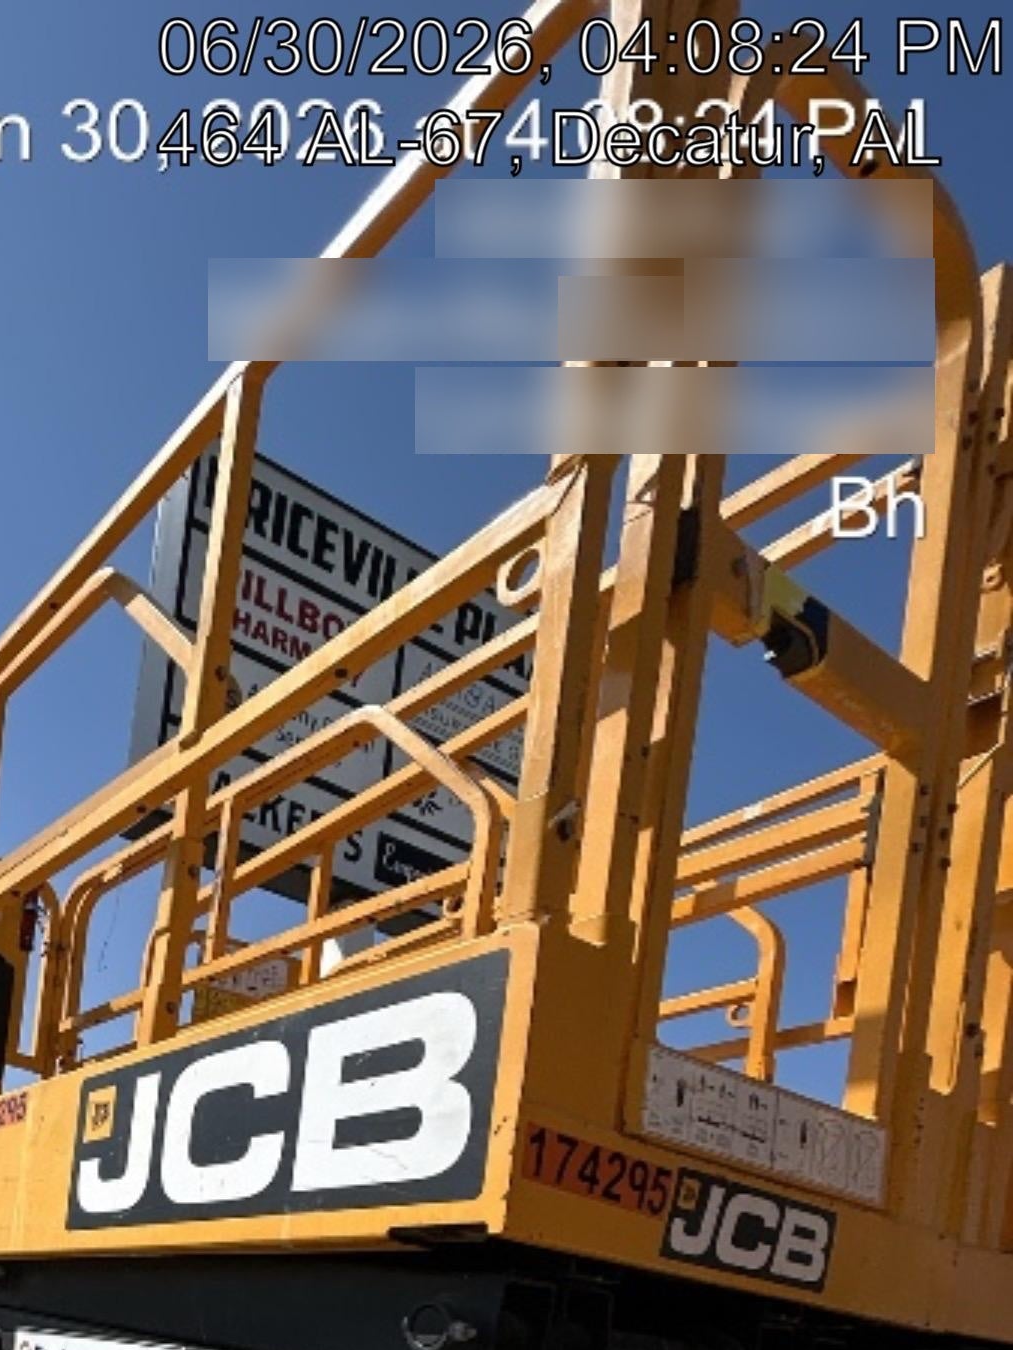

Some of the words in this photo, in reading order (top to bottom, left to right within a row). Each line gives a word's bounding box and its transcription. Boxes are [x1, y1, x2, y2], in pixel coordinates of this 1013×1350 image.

[77, 991, 477, 1213] JCB
[528, 1127, 672, 1216] 174295
[670, 1183, 833, 1283] JCB
